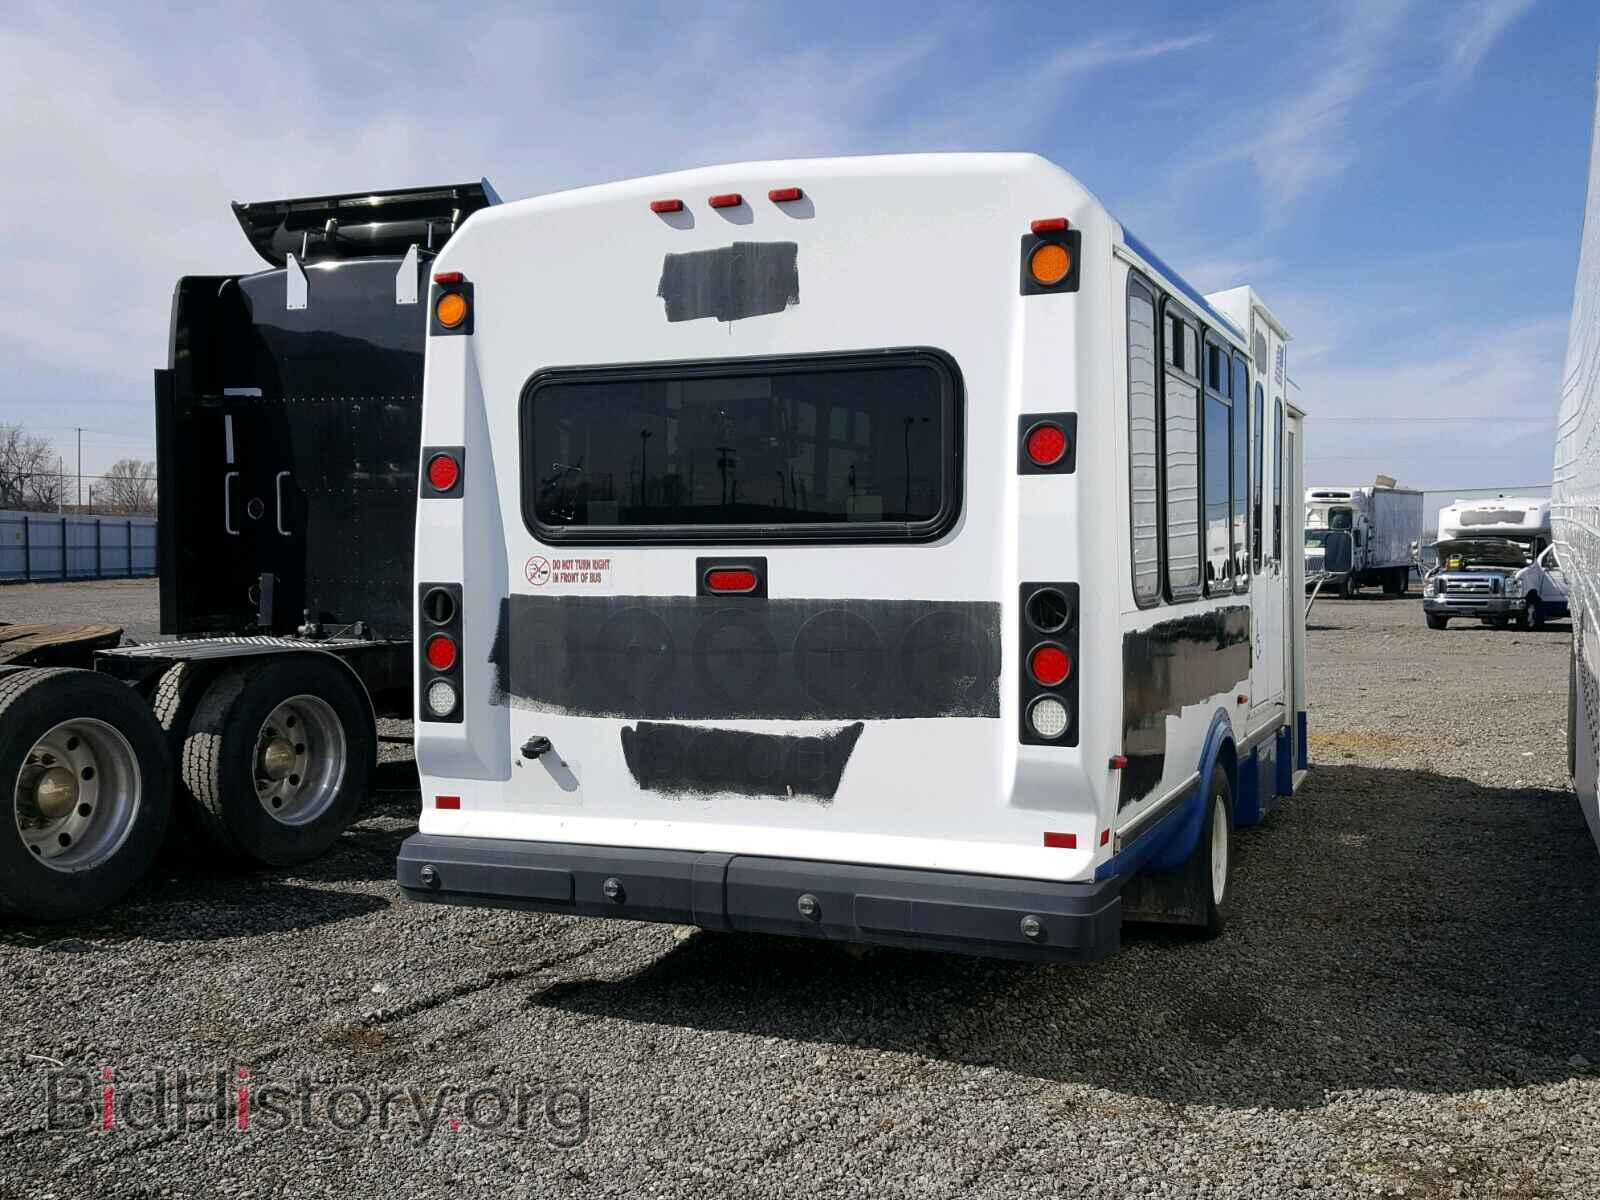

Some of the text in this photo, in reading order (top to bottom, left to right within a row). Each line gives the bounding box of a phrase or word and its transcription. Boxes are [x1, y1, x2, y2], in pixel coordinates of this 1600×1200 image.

[552, 559, 610, 570] DO NOT TURN RIGHT
[552, 573, 601, 583] IN FRONT OF BUS
